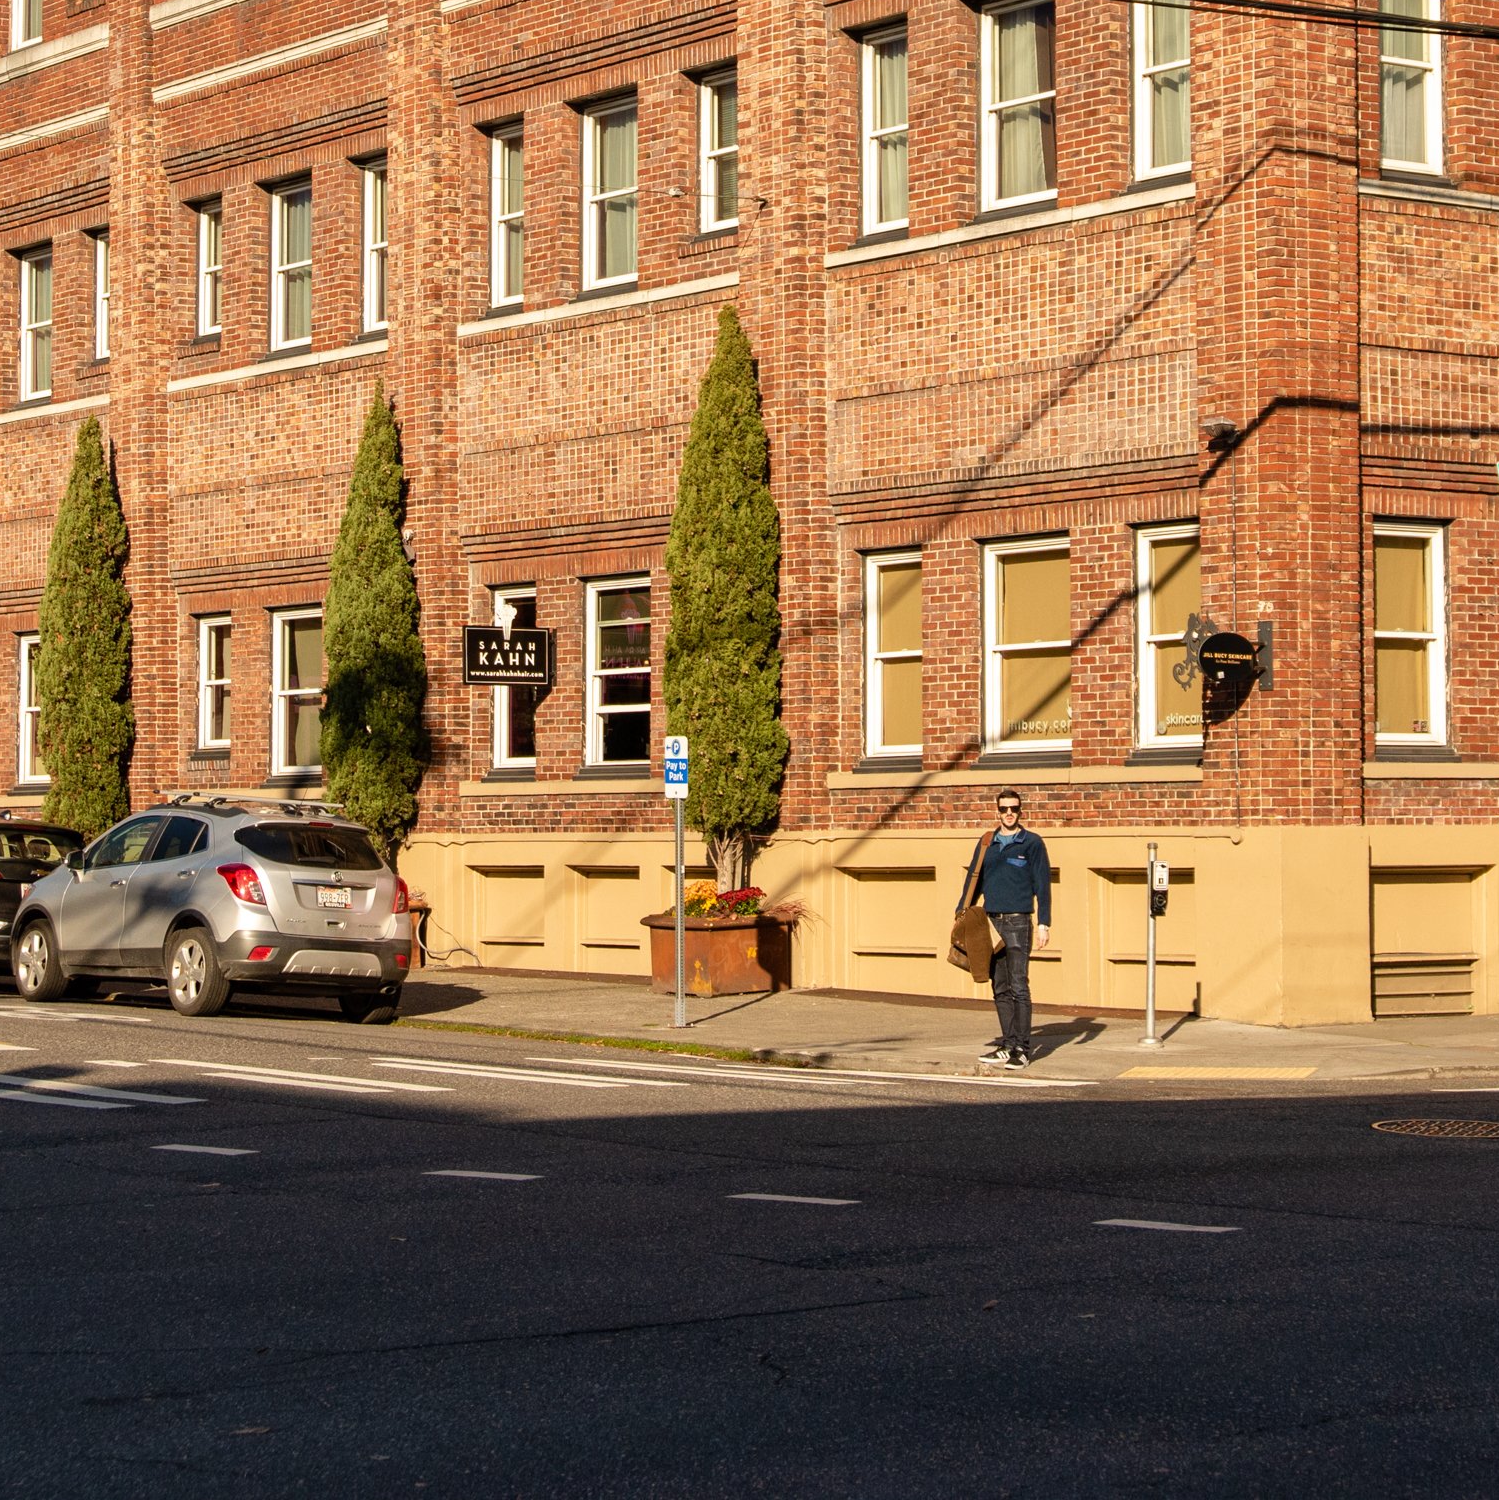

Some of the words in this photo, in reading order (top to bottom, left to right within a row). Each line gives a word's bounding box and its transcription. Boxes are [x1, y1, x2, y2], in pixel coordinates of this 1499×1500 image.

[478, 641, 536, 651] SARAH
[479, 652, 536, 666] KAHN
[470, 670, 544, 678] www.sarahkahnhair.com
[666, 761, 678, 771] Pay
[679, 761, 686, 770] to
[669, 771, 683, 781] Park
